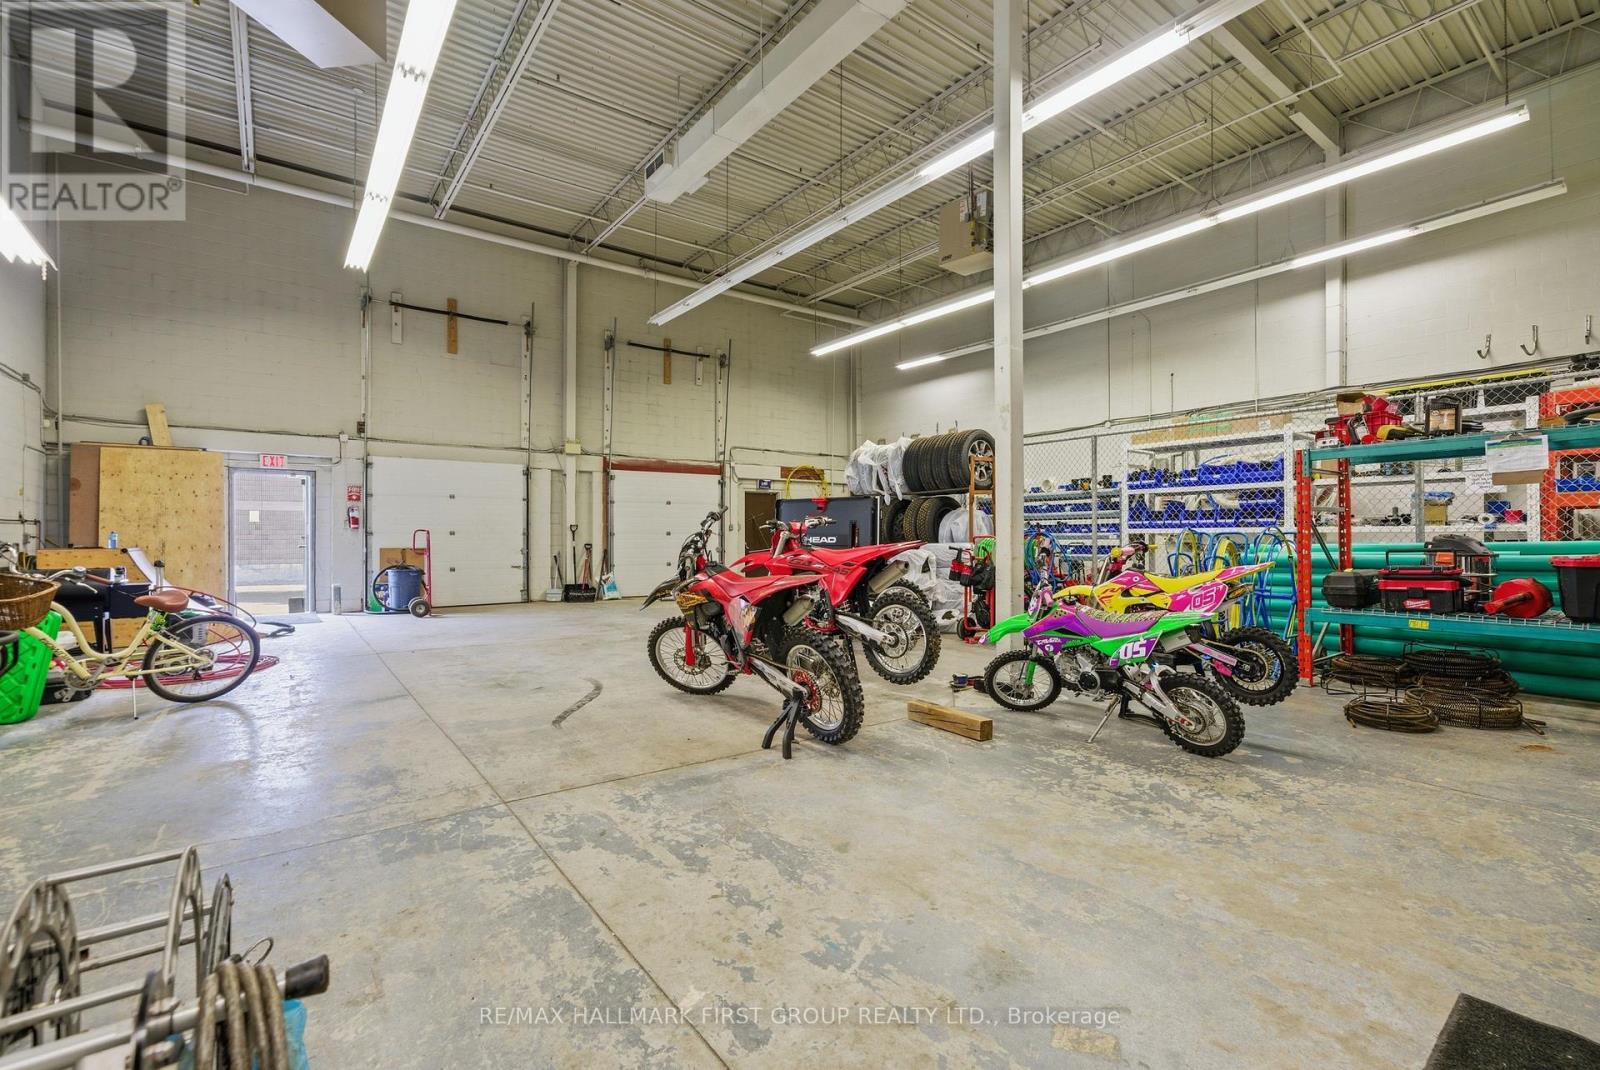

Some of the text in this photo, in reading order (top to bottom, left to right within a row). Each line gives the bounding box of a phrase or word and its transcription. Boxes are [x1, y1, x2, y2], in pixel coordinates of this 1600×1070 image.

[262, 455, 285, 467] EXIT
[1191, 587, 1216, 610] 05
[1119, 639, 1148, 660] 05
